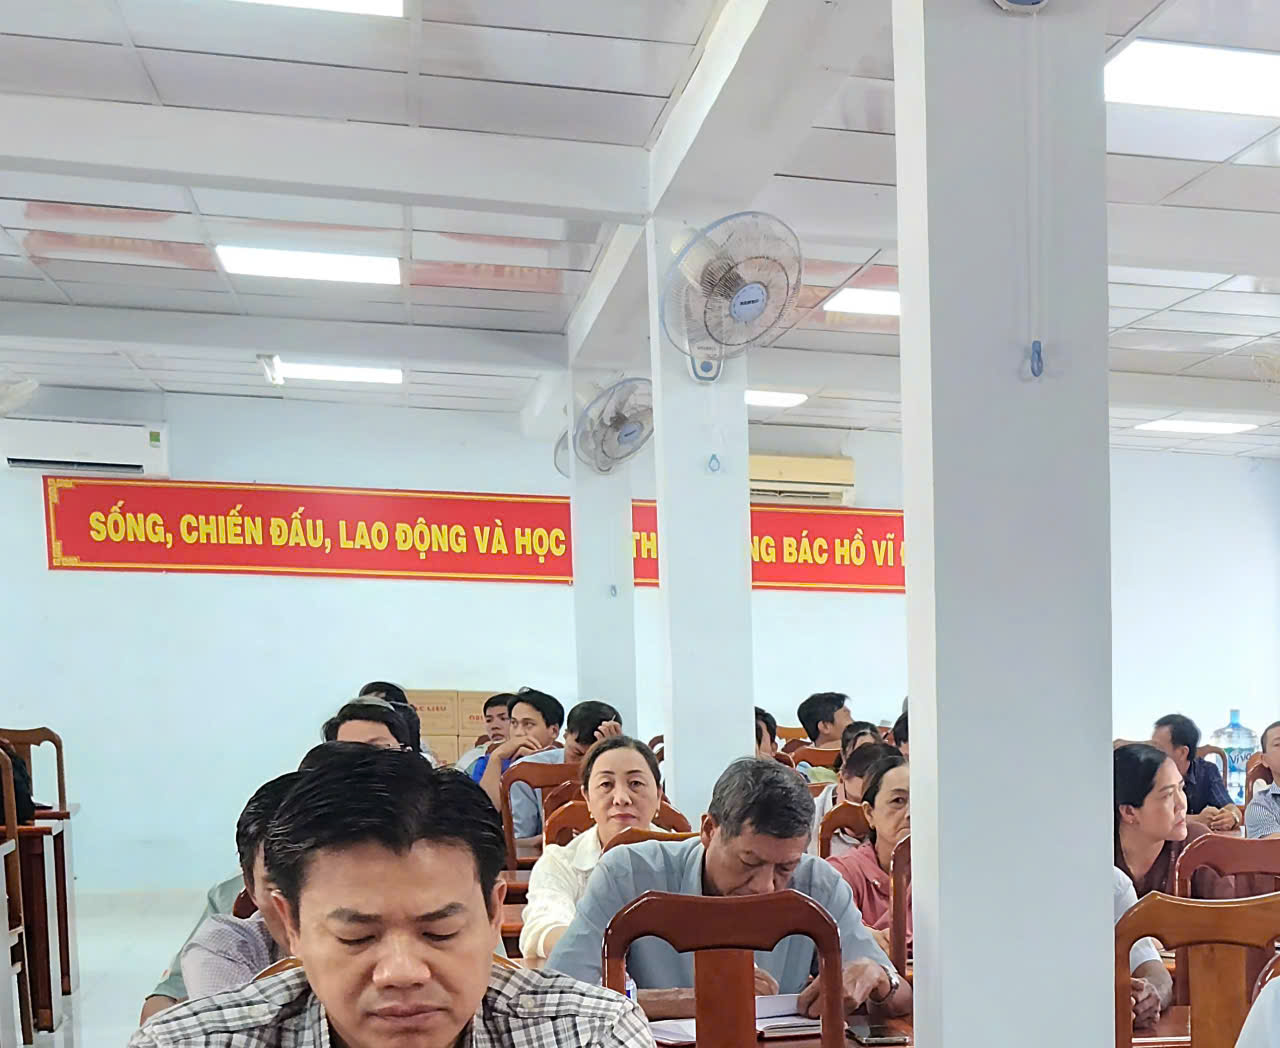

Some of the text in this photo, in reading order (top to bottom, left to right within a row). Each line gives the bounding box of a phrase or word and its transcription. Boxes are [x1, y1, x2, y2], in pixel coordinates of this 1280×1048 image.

[90, 501, 173, 549] SỐNG,
[180, 504, 263, 545] CHIẾN
[270, 507, 332, 553] ĐẤU,
[338, 519, 389, 551] LAO
[395, 517, 467, 559] ĐỘNG
[473, 518, 509, 555] VÀ
[515, 527, 566, 564] HỌC
[783, 530, 829, 565] BÁC
[835, 528, 866, 567] HỒ
[872, 533, 895, 567] VĨ
